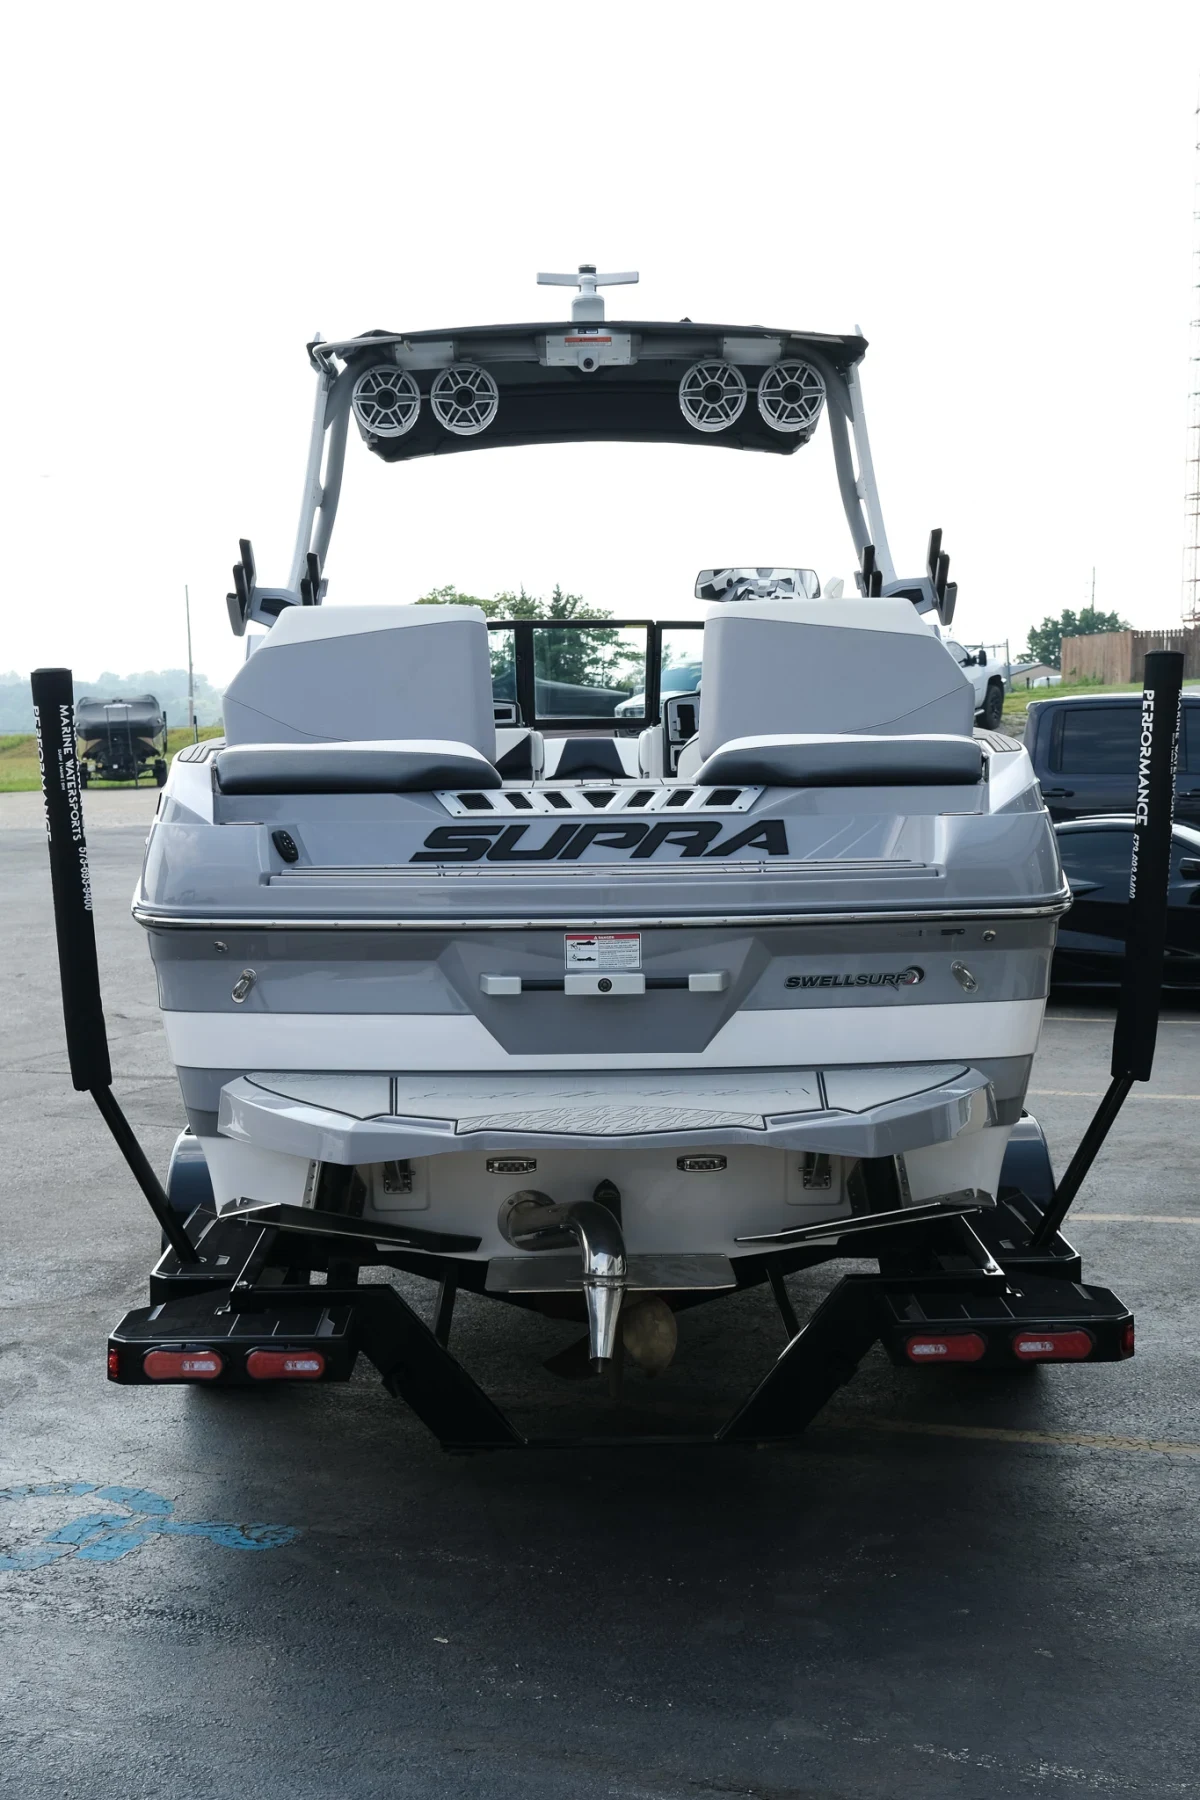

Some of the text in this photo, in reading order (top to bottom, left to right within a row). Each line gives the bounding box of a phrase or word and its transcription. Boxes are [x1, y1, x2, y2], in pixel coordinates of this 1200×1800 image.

[59, 704, 73, 756] MARINE
[1136, 690, 1155, 826] PERFORMANCE
[65, 758, 82, 841] WATERSPORTS
[409, 819, 789, 862] SUPRA
[785, 972, 908, 991] SWELLSURF
